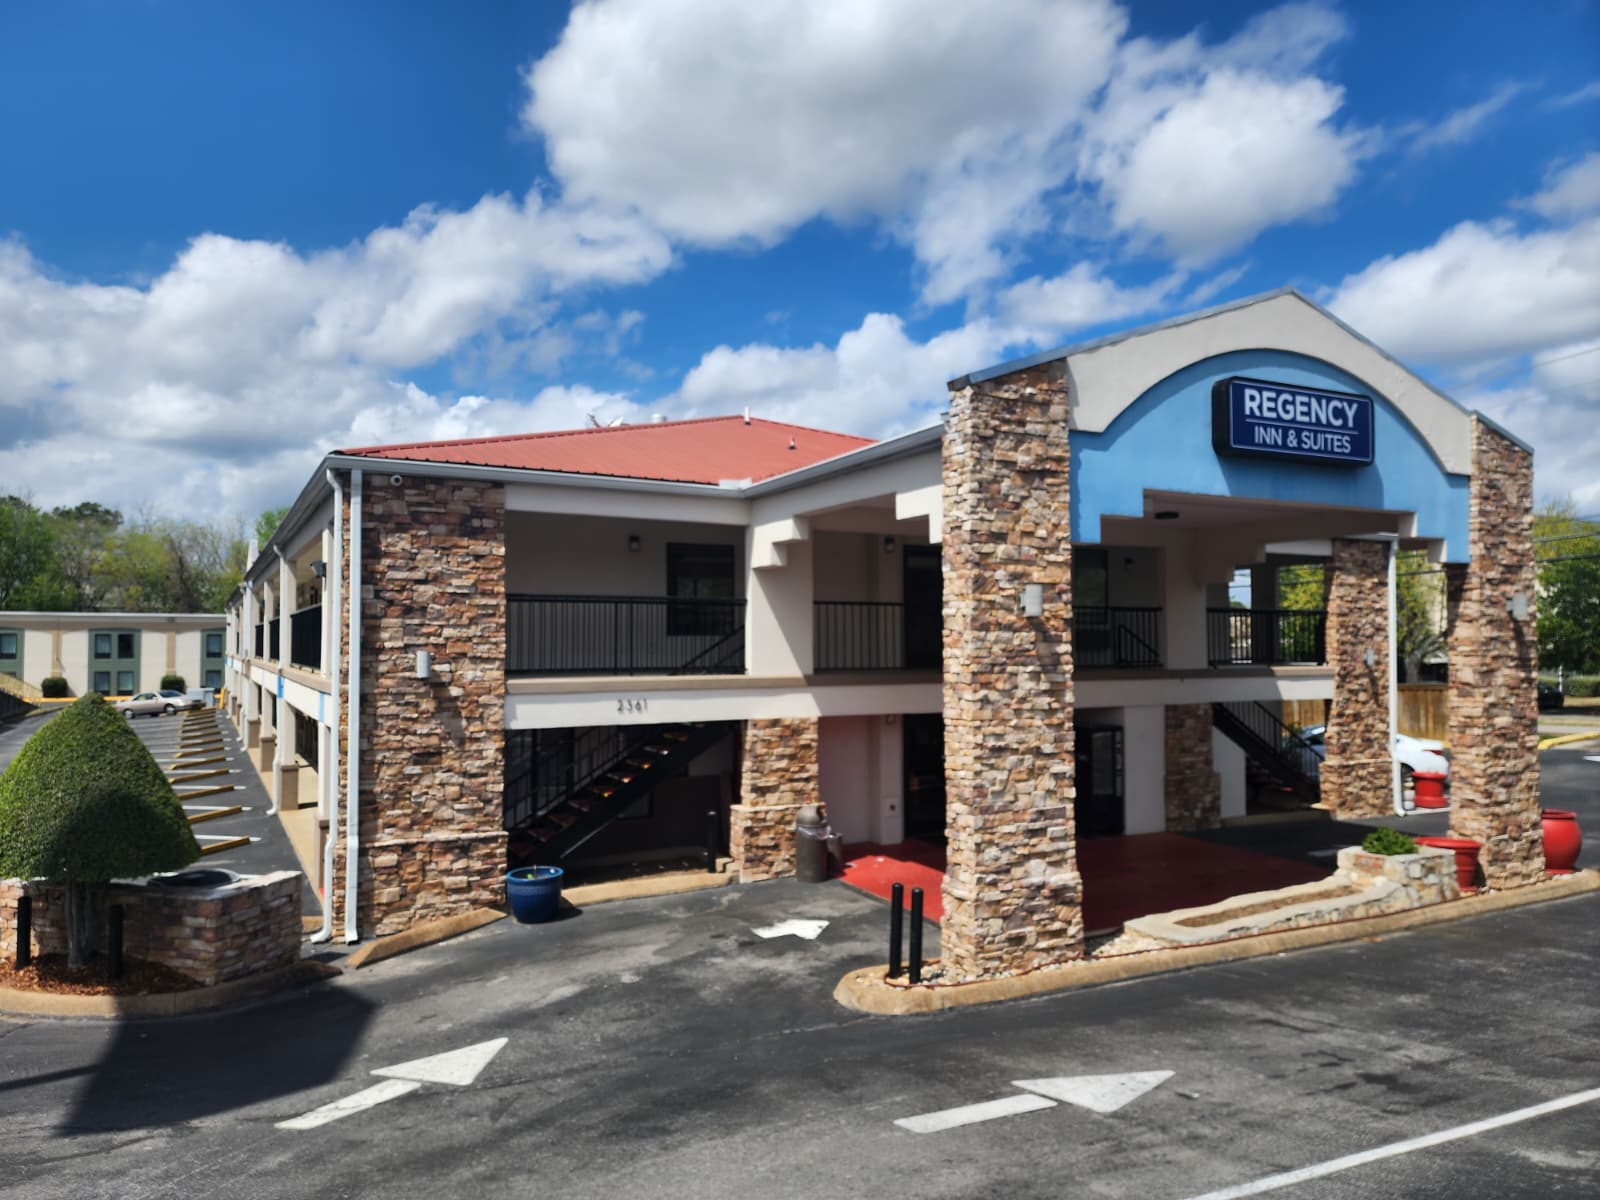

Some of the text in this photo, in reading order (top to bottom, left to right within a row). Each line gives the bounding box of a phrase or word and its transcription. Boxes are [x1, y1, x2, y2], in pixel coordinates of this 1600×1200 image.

[1244, 388, 1358, 428] REGENCY
[1254, 425, 1351, 453] INN & SUITES
[617, 697, 648, 713] 2361
